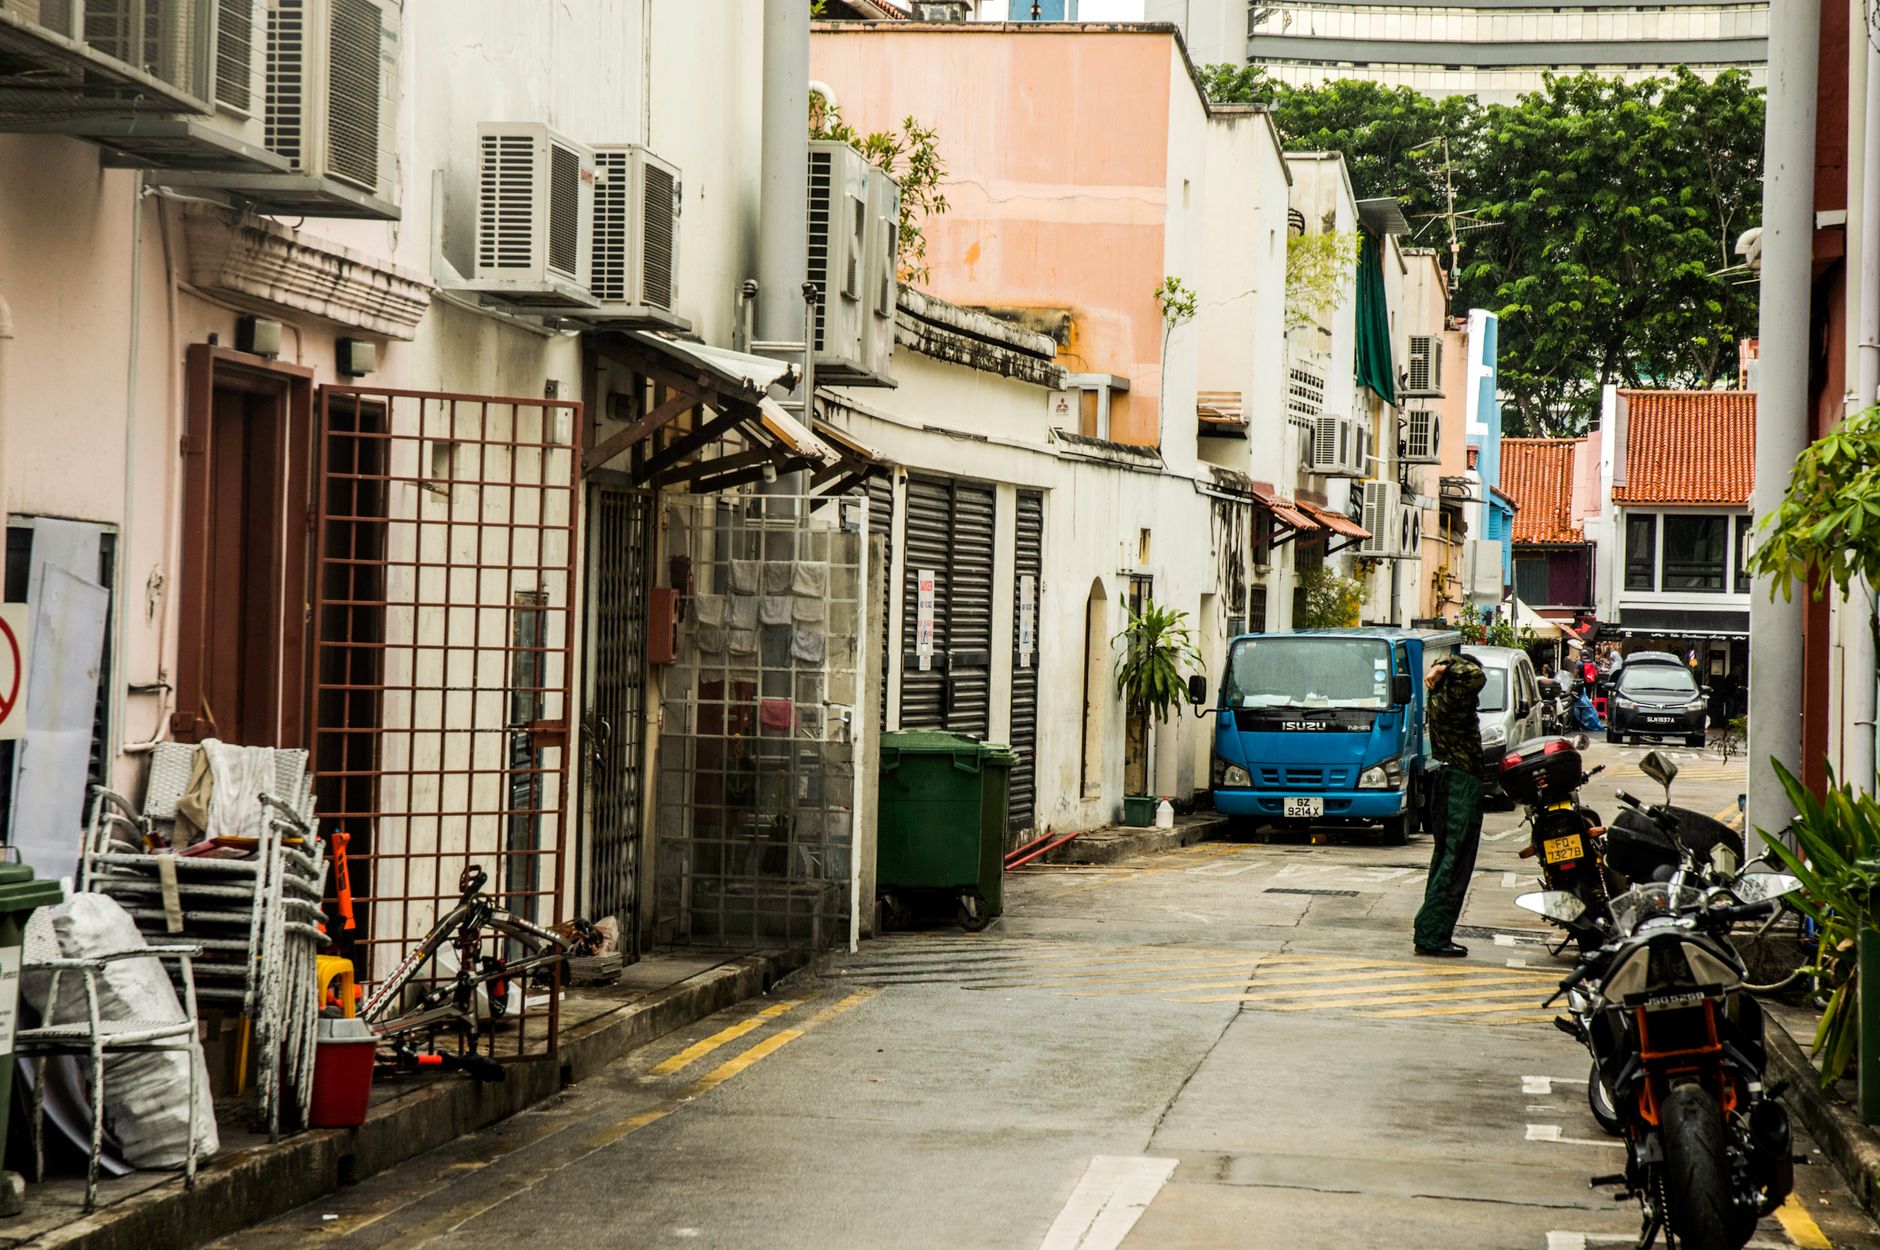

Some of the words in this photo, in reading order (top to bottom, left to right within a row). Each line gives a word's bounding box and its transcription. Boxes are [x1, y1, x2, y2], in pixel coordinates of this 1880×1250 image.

[1282, 721, 1326, 731] ISUZU
[1297, 798, 1310, 807] GZ
[1288, 807, 1311, 816] 9214
[1555, 837, 1570, 849] FQ
